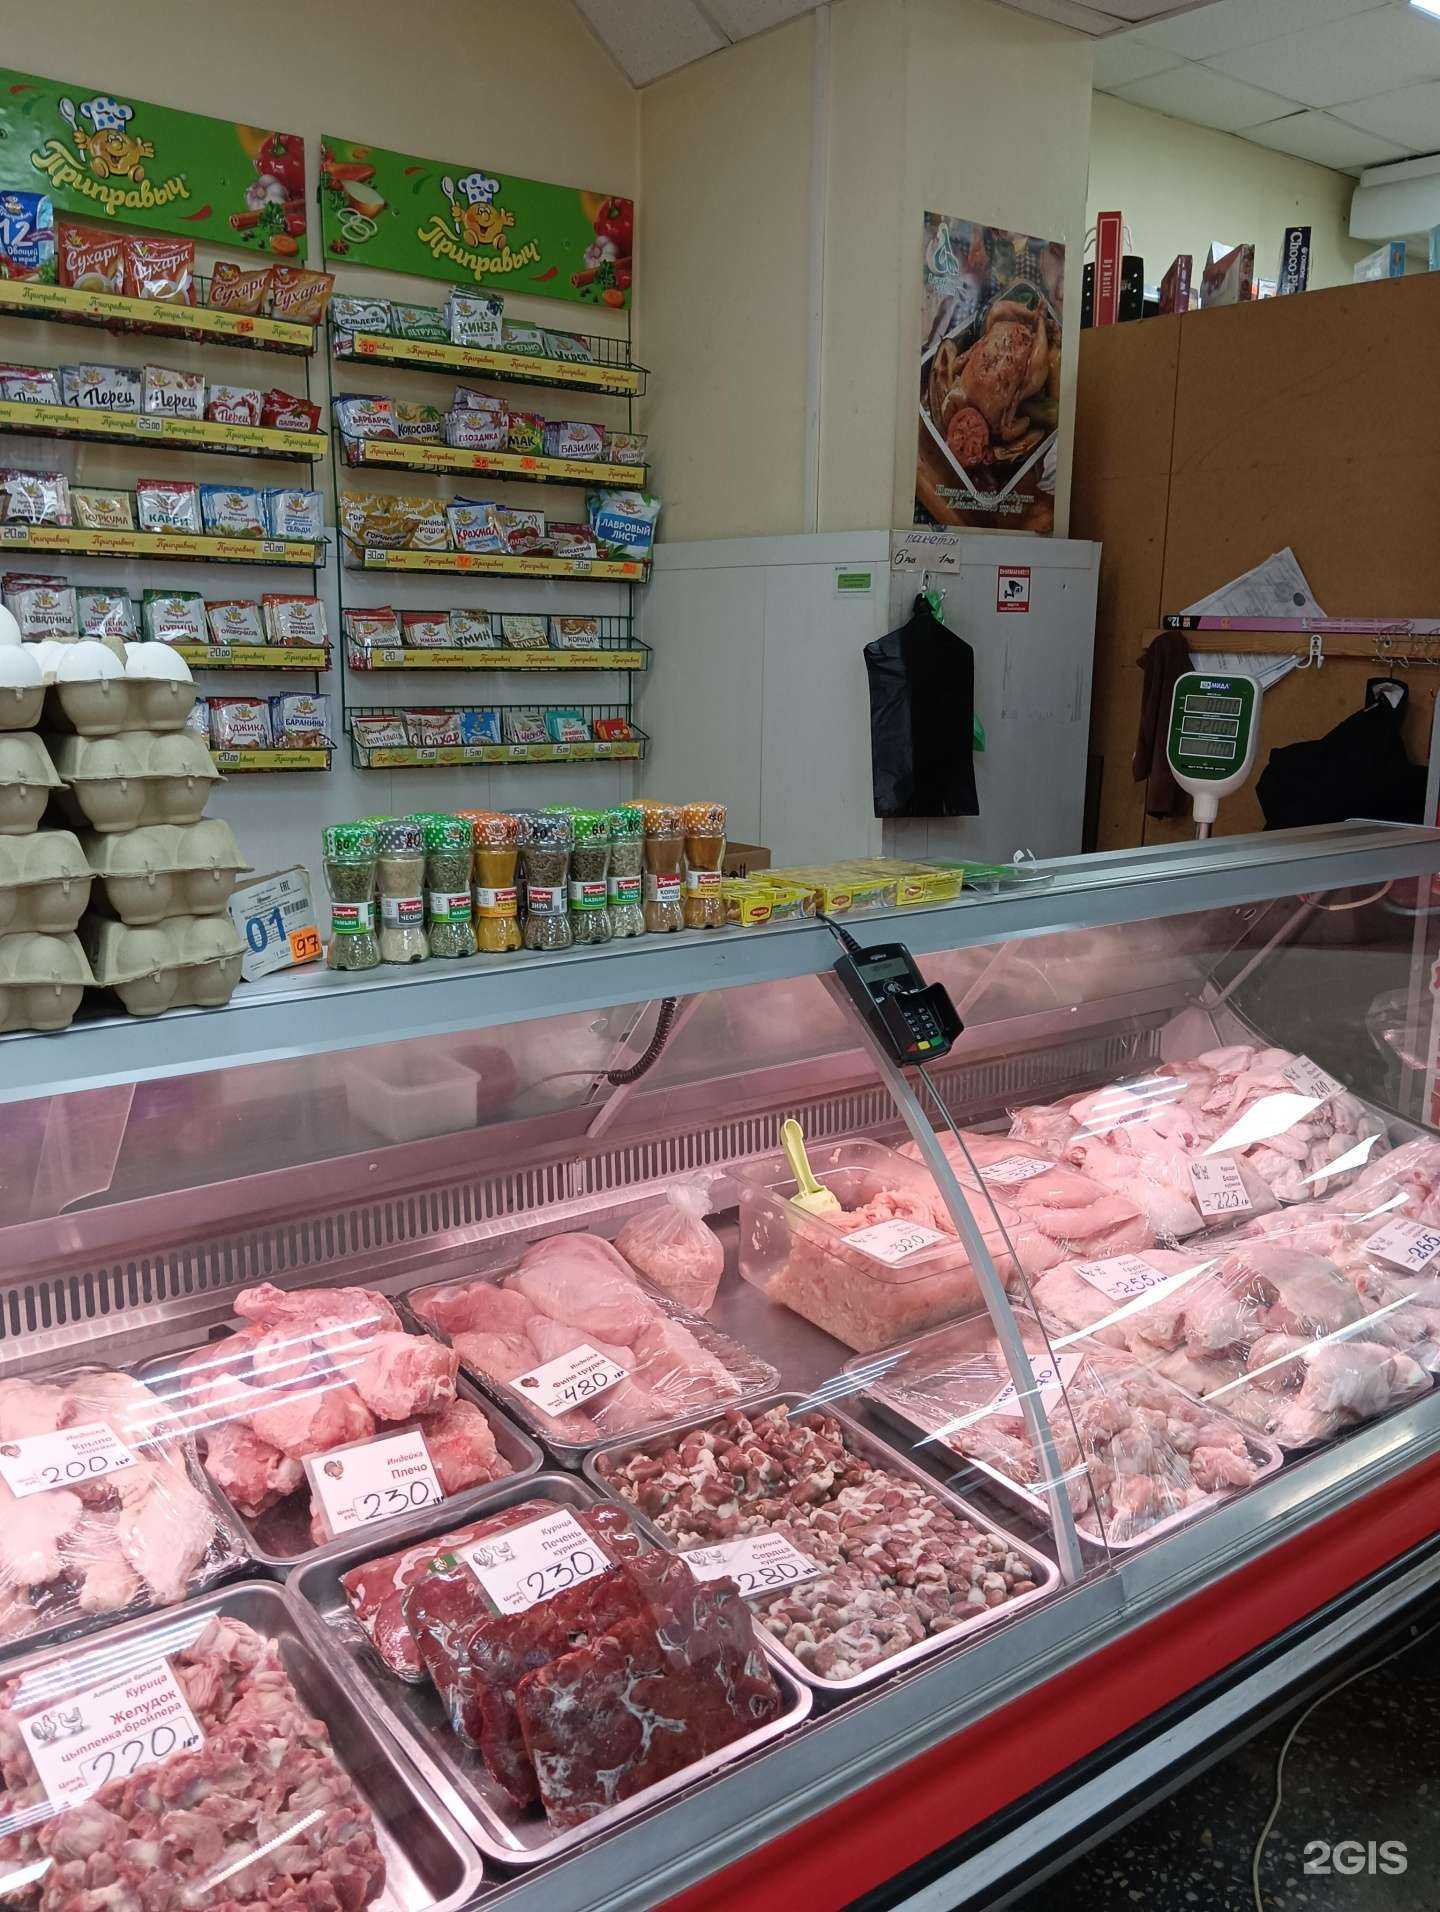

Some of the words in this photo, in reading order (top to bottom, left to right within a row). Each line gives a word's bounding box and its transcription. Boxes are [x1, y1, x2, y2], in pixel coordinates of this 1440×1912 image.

[30, 139, 190, 216] Приправыч
[0, 218, 33, 246] 12
[66, 246, 118, 275] Сухари
[416, 215, 541, 281] Приправыч
[211, 278, 265, 306] Сухари
[274, 283, 327, 312] Сухари
[458, 320, 498, 334] КИНЗА
[84, 387, 135, 410] Перец
[150, 388, 198, 416] Перец
[218, 409, 250, 425] Перец
[278, 418, 309, 430] ПАПРИКА
[507, 435, 535, 447] МАК
[561, 442, 600, 453] БАЗИЛИК
[456, 524, 499, 544] Крахмал
[601, 519, 651, 536] ЛАВРОВЫЙ
[611, 531, 637, 543] ЛИСТ
[159, 623, 199, 634] КУРИЦЫ
[227, 723, 265, 733] АДЖИКА
[245, 905, 287, 953] 01
[295, 934, 319, 958] 97
[564, 1372, 608, 1401] 480
[42, 1456, 108, 1484] 200
[387, 1451, 424, 1466] Индейка
[391, 1463, 428, 1480] Плечо
[363, 1481, 429, 1521] 230
[541, 1519, 573, 1537] Курица
[542, 1531, 582, 1551] Печень
[527, 1551, 594, 1600] 230
[737, 1563, 799, 1591] 280
[125, 1673, 169, 1699] Курица
[109, 1689, 178, 1725] Желудок
[61, 1701, 182, 1763] цыпленка-бройлера
[92, 1726, 176, 1786] 220
